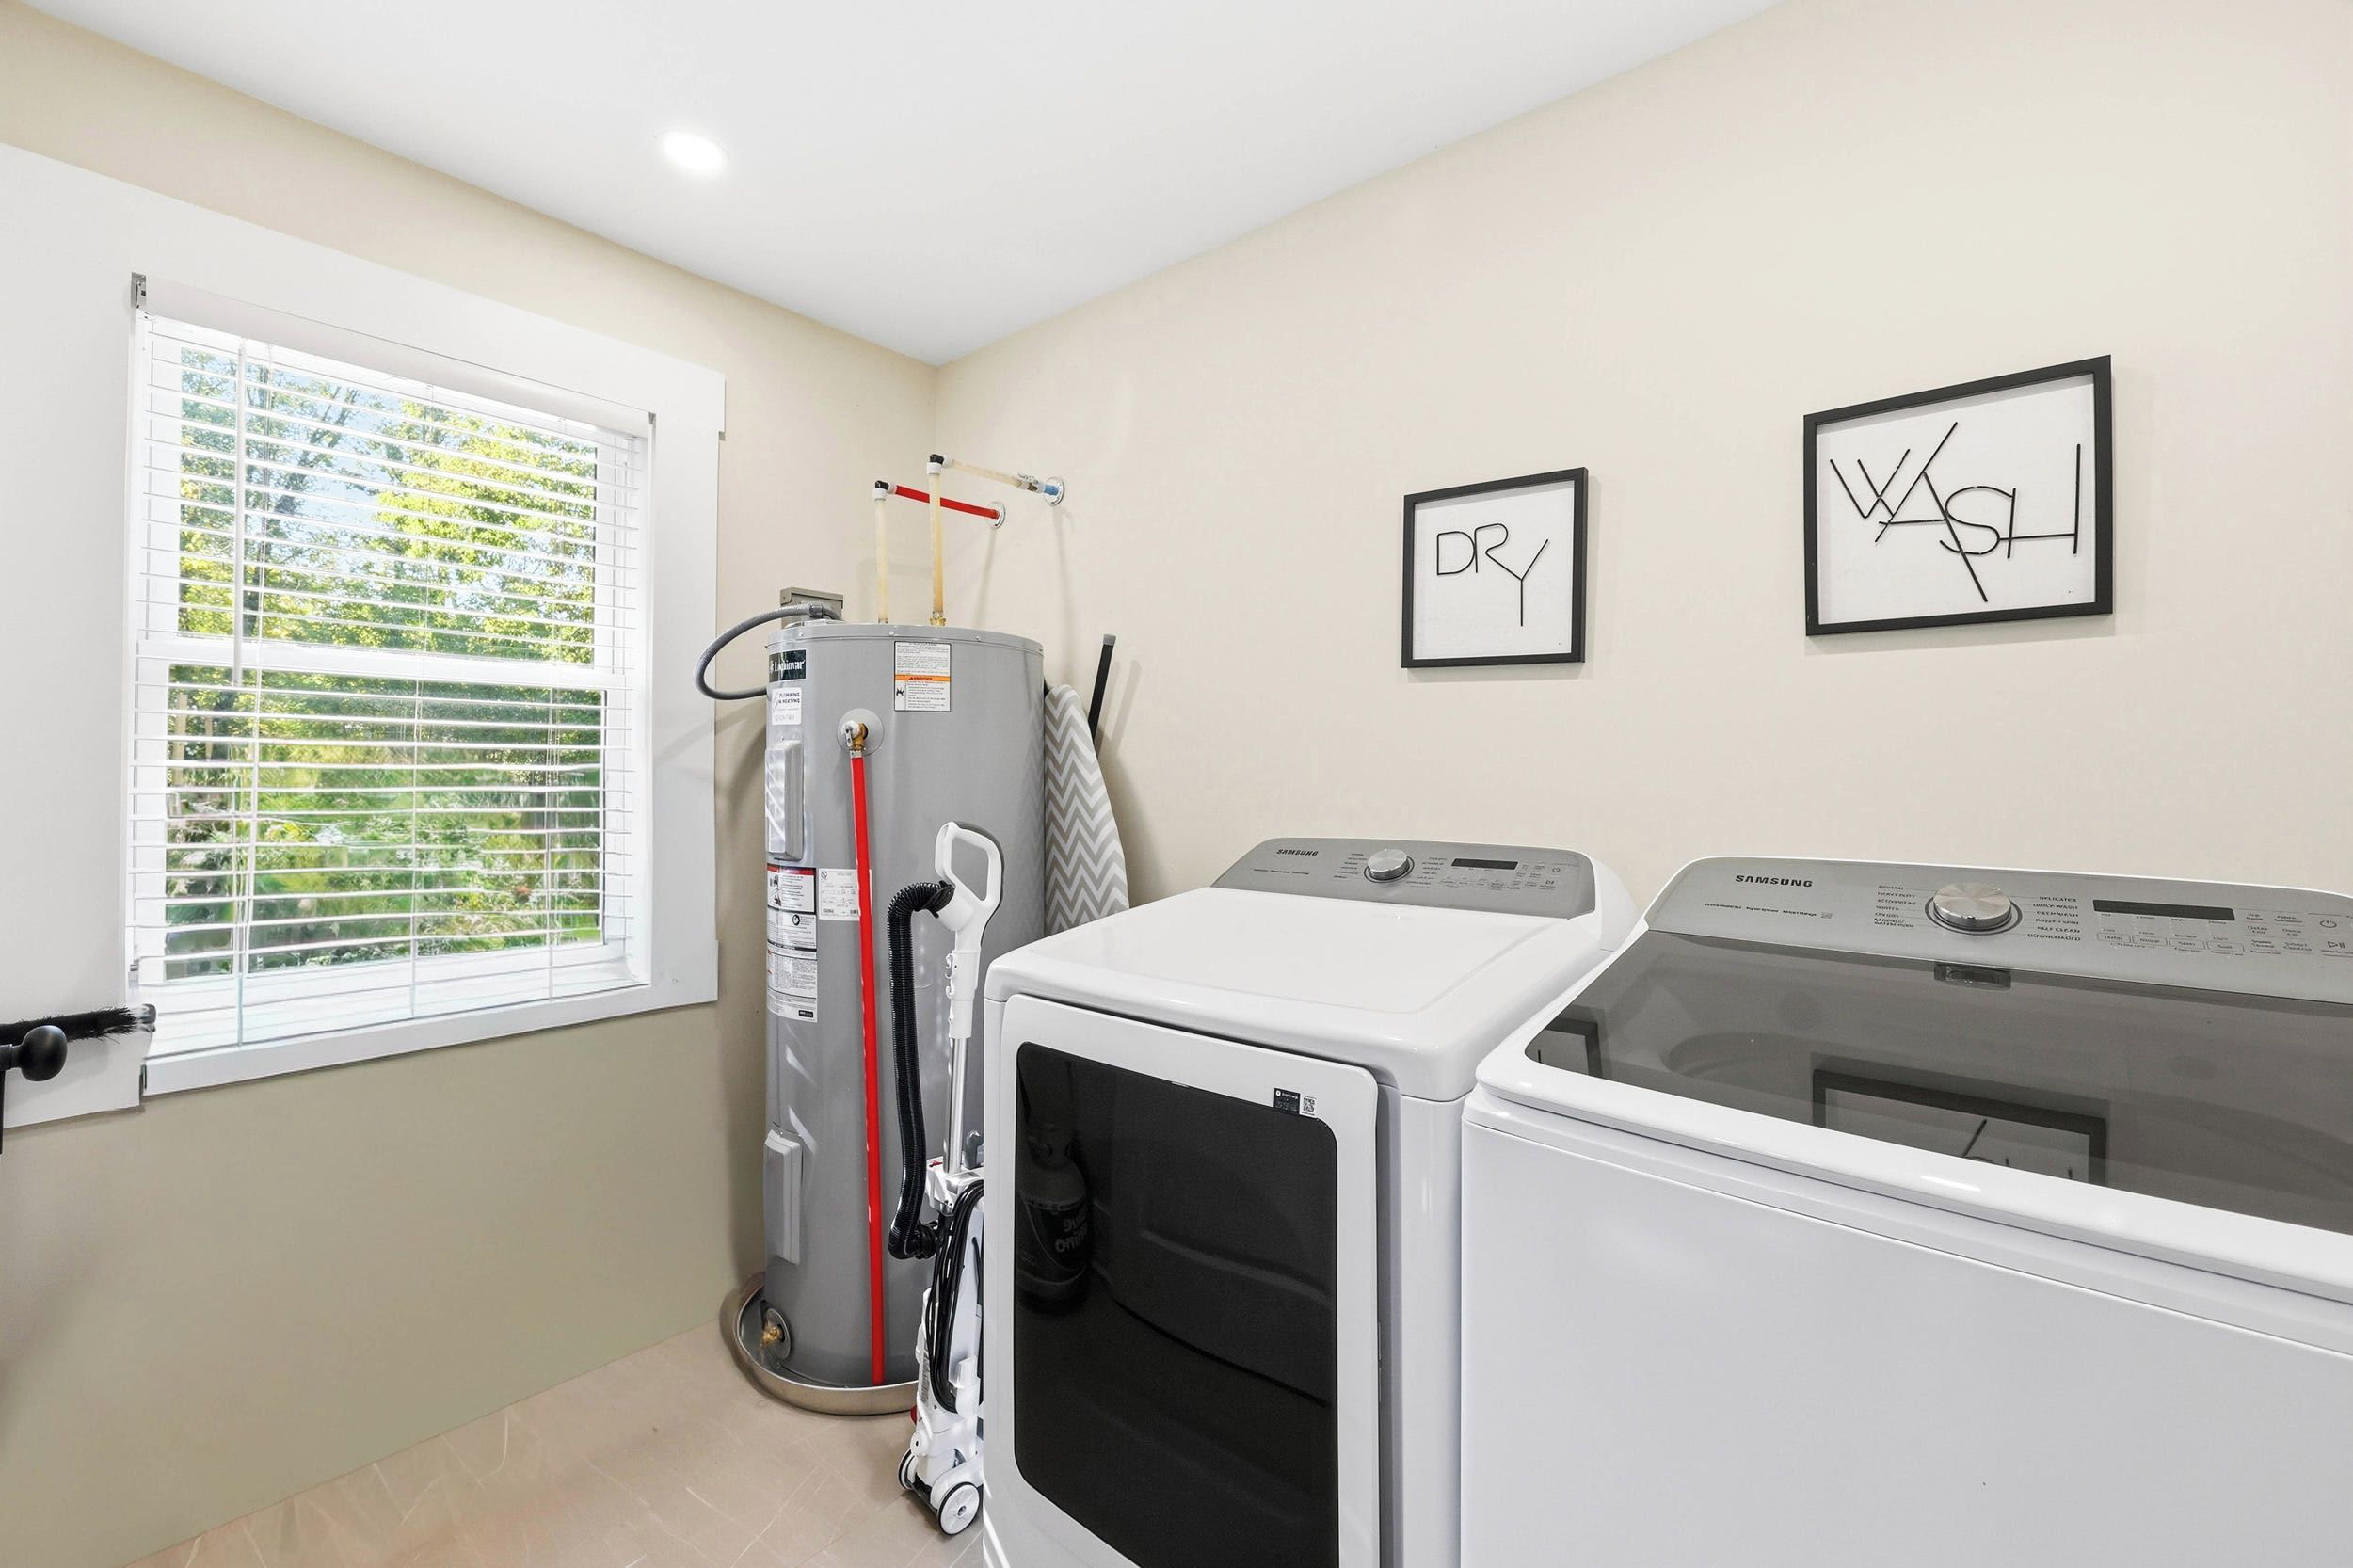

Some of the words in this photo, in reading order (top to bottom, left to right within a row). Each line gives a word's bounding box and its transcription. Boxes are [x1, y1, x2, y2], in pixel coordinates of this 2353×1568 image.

[1830, 421, 2081, 603] WASH
[1436, 522, 1549, 627] DRY
[1276, 848, 1319, 856] SAMSUNG
[1736, 874, 1813, 888] SAMSUNG
